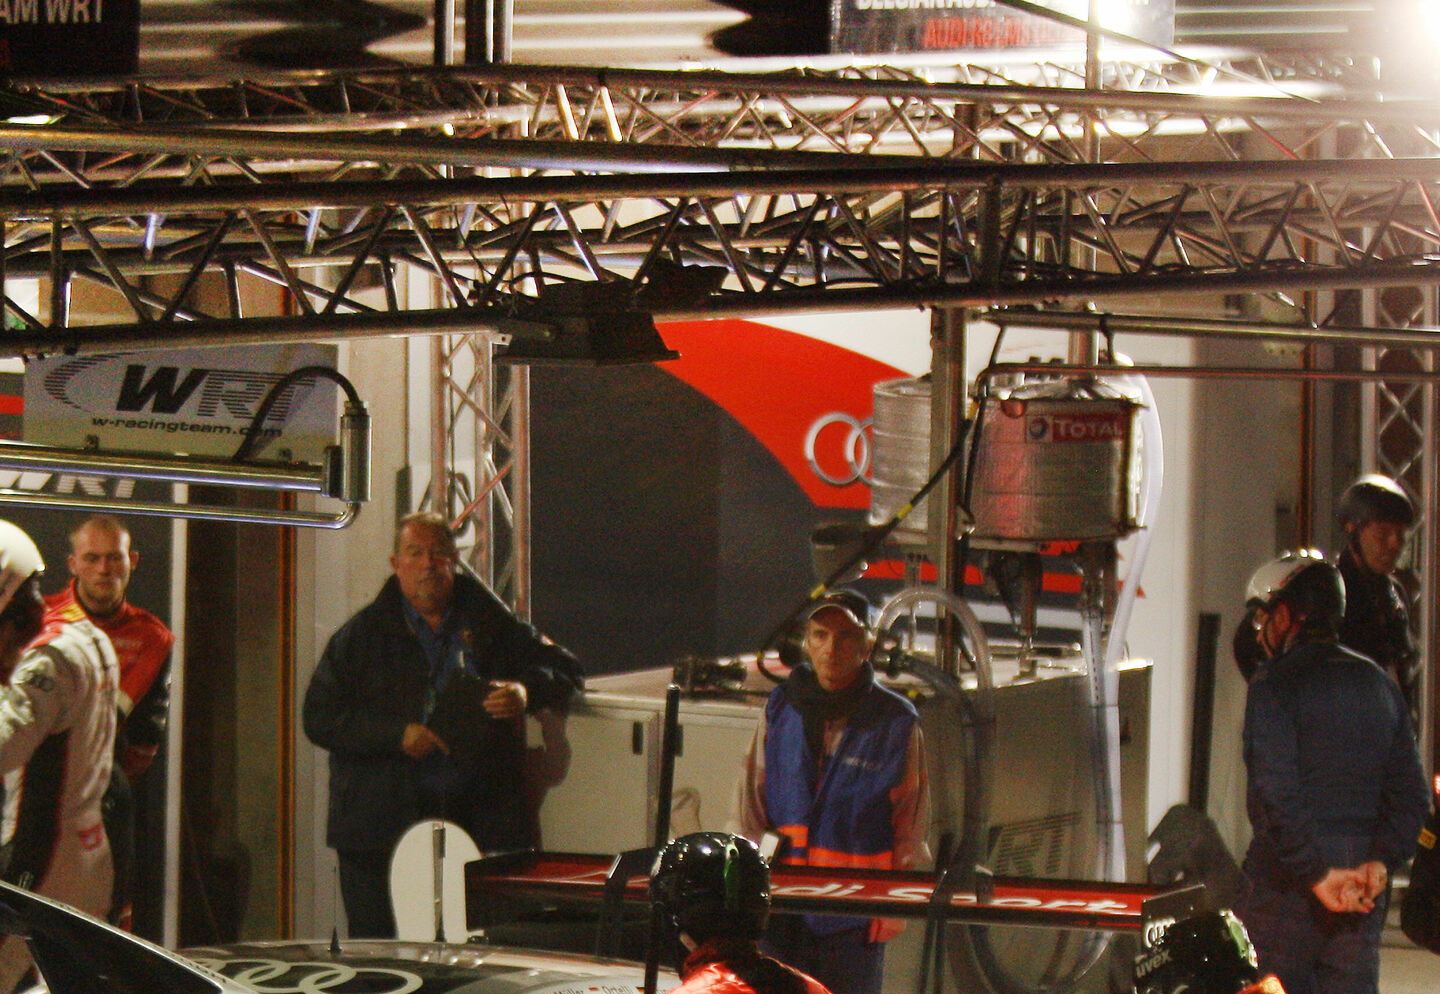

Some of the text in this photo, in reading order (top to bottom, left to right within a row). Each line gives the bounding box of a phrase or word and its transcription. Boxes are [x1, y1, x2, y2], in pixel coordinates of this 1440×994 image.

[43, 0, 104, 24] WRT
[116, 364, 317, 422] WRT
[91, 416, 282, 438] w-racingteam.cm
[1052, 420, 1122, 439] TOTAL
